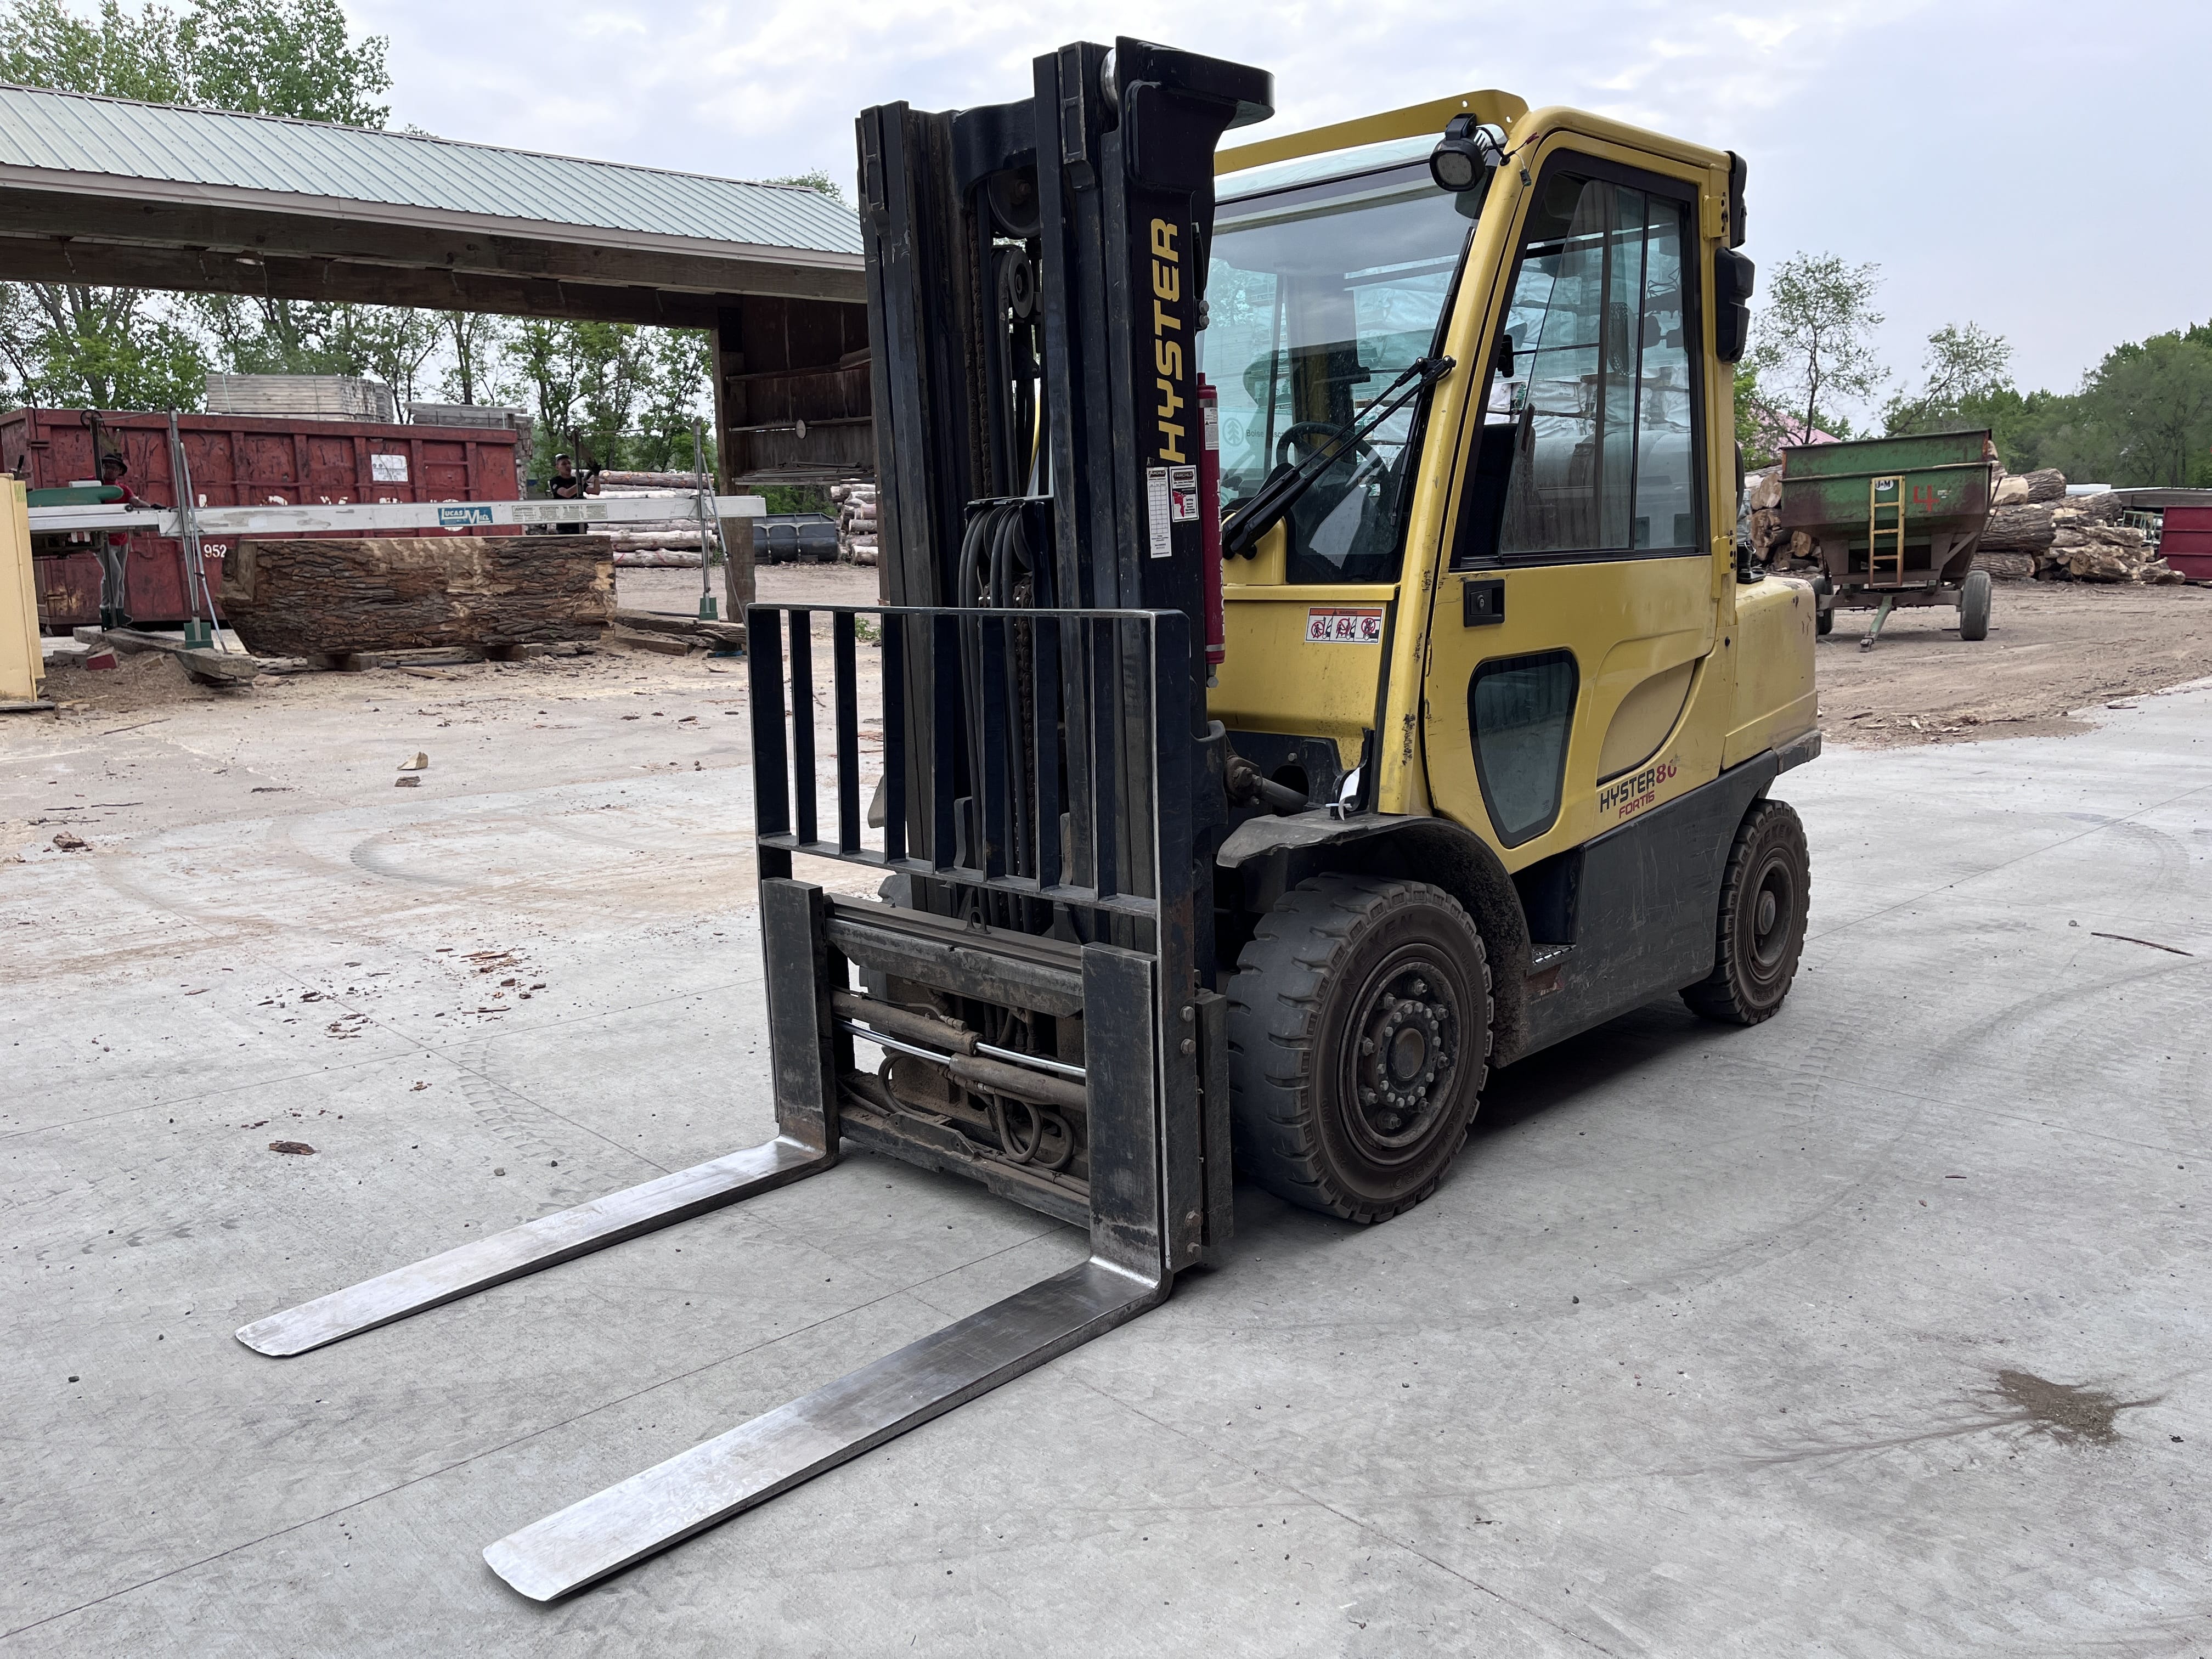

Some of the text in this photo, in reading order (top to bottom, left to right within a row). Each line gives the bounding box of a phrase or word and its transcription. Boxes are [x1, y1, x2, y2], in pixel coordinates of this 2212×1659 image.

[1151, 218, 1185, 464] HYSTER
[1913, 484, 1940, 512] 4
[441, 508, 467, 520] LUCAS
[204, 544, 227, 558] 952
[1600, 768, 1655, 813] HYSTER
[1619, 790, 1655, 819] FORTIS
[1340, 913, 1414, 996] NEXEN
